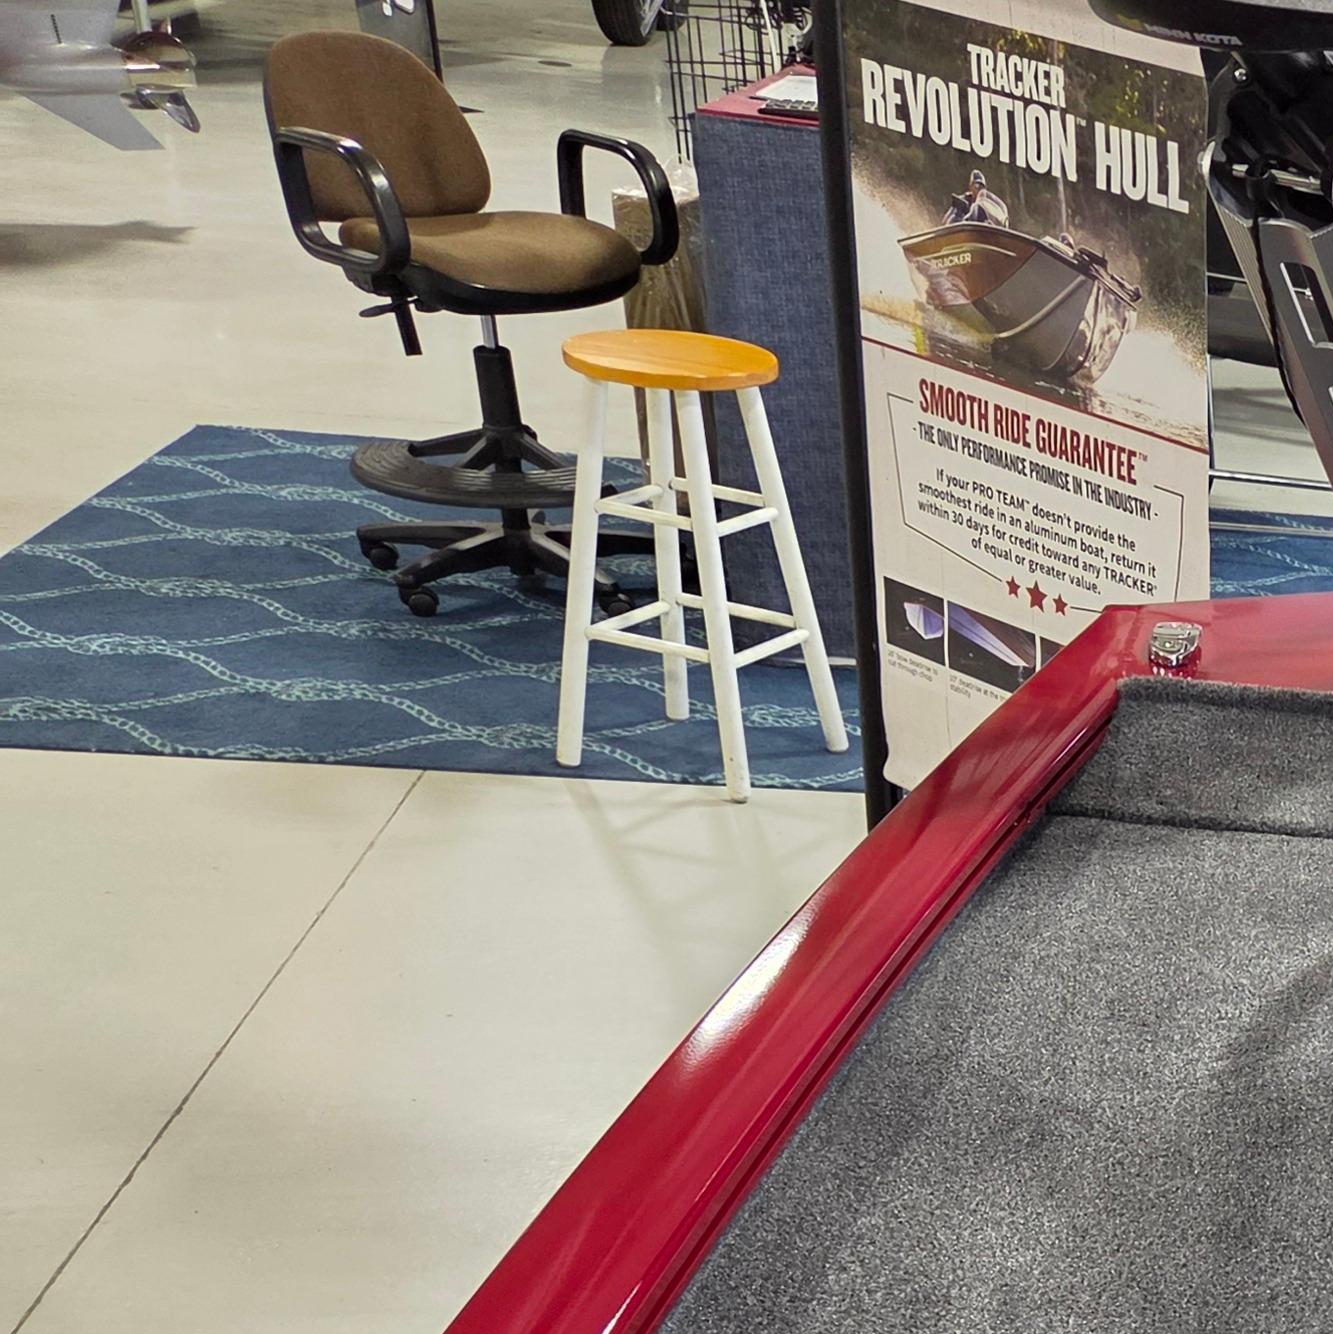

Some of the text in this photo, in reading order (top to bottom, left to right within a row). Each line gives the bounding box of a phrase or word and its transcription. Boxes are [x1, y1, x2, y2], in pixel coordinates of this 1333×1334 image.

[966, 43, 1067, 109] TRACKER
[1193, 32, 1244, 46] KOTA
[1093, 120, 1190, 214] HULL
[919, 378, 990, 434] SMOOTH
[993, 403, 1031, 449] RIDE
[918, 421, 935, 444] THE
[936, 428, 959, 453] ONLY
[961, 436, 1028, 477] PERFORMANCE
[1029, 460, 1071, 492] PROMISE
[1072, 475, 1083, 497] IN
[1084, 479, 1104, 504] THE
[1104, 486, 1152, 520] INDUSTRY
[936, 467, 944, 482] If
[946, 473, 970, 491] your
[972, 481, 994, 500] PRO
[1032, 502, 1072, 529] doesn't
[1074, 520, 1115, 545] provide
[1117, 532, 1136, 552] the
[918, 482, 1157, 579] smoothest ride in an aluminum boat, return it
[918, 499, 950, 521] within
[952, 510, 964, 526] 30
[966, 515, 990, 536] days
[992, 524, 1007, 541] for
[1009, 533, 1040, 555] credit
[1041, 543, 1080, 569] toward
[1082, 560, 1102, 579] any
[971, 537, 1101, 596] of equal or greater value.
